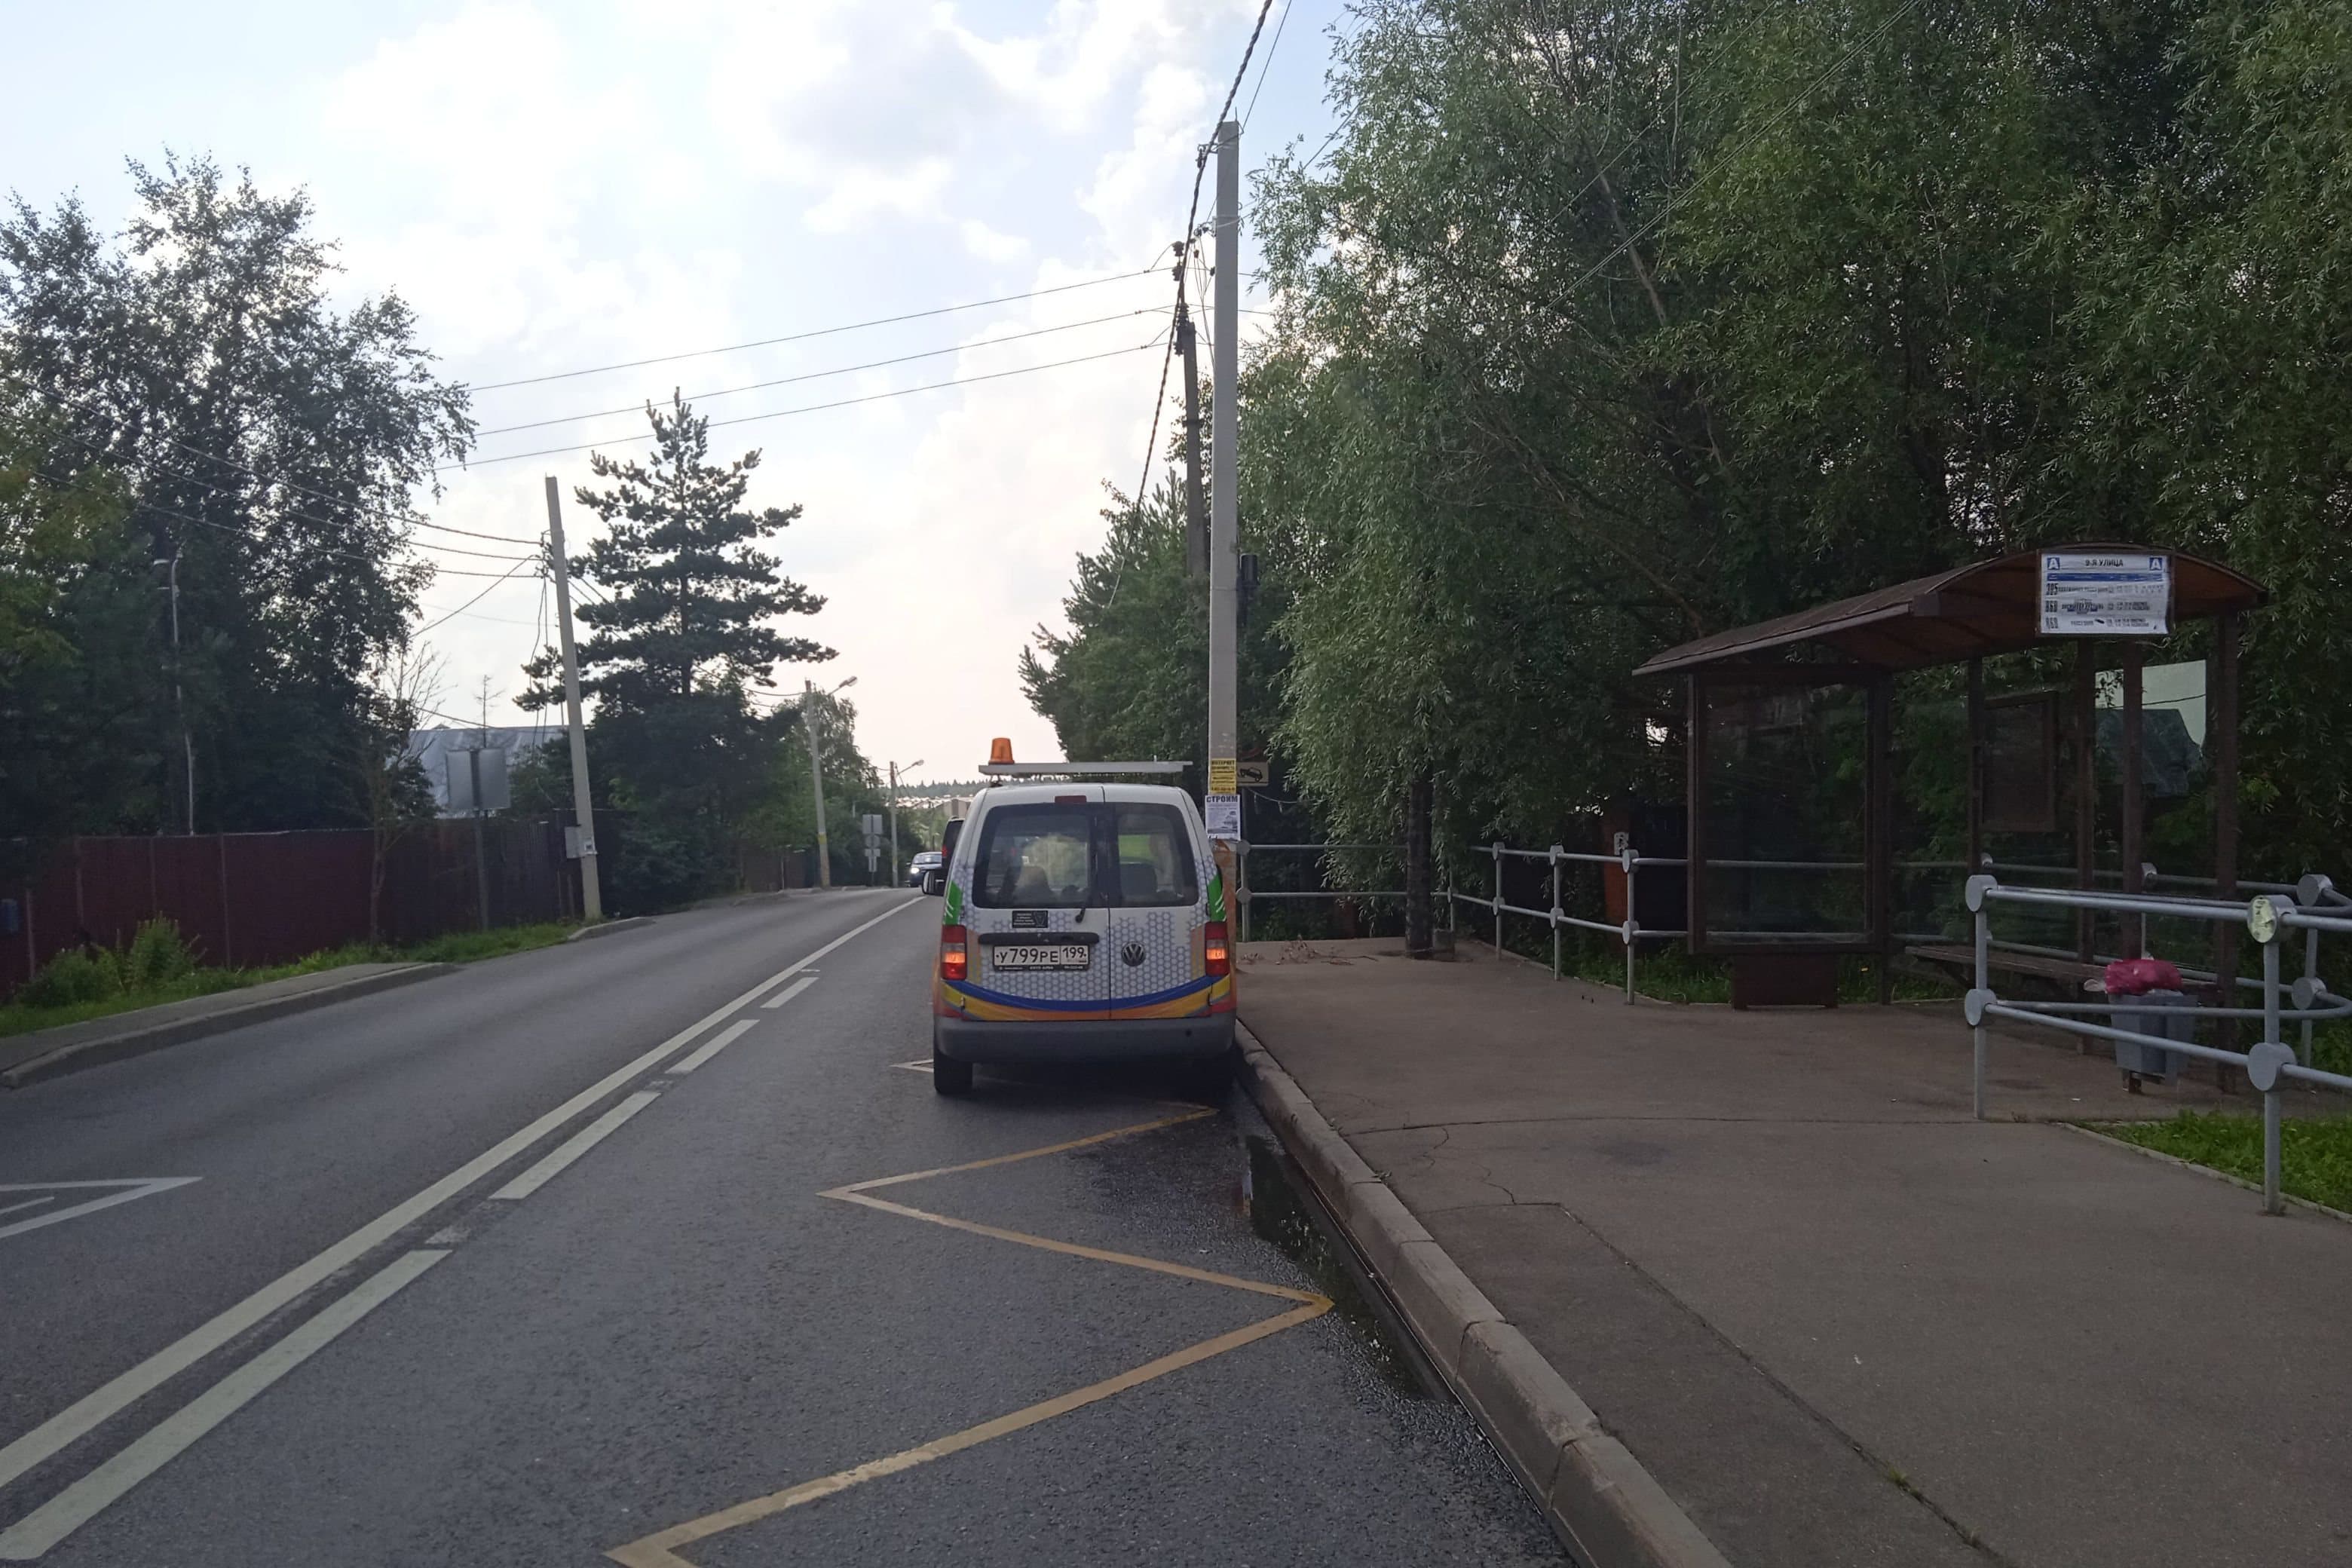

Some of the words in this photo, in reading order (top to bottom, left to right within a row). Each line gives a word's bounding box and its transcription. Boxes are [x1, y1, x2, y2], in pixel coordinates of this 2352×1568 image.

[2099, 559, 2124, 568] УЛИЦА
[999, 948, 1058, 963] У799РЕ
[1061, 946, 1086, 958] 199
